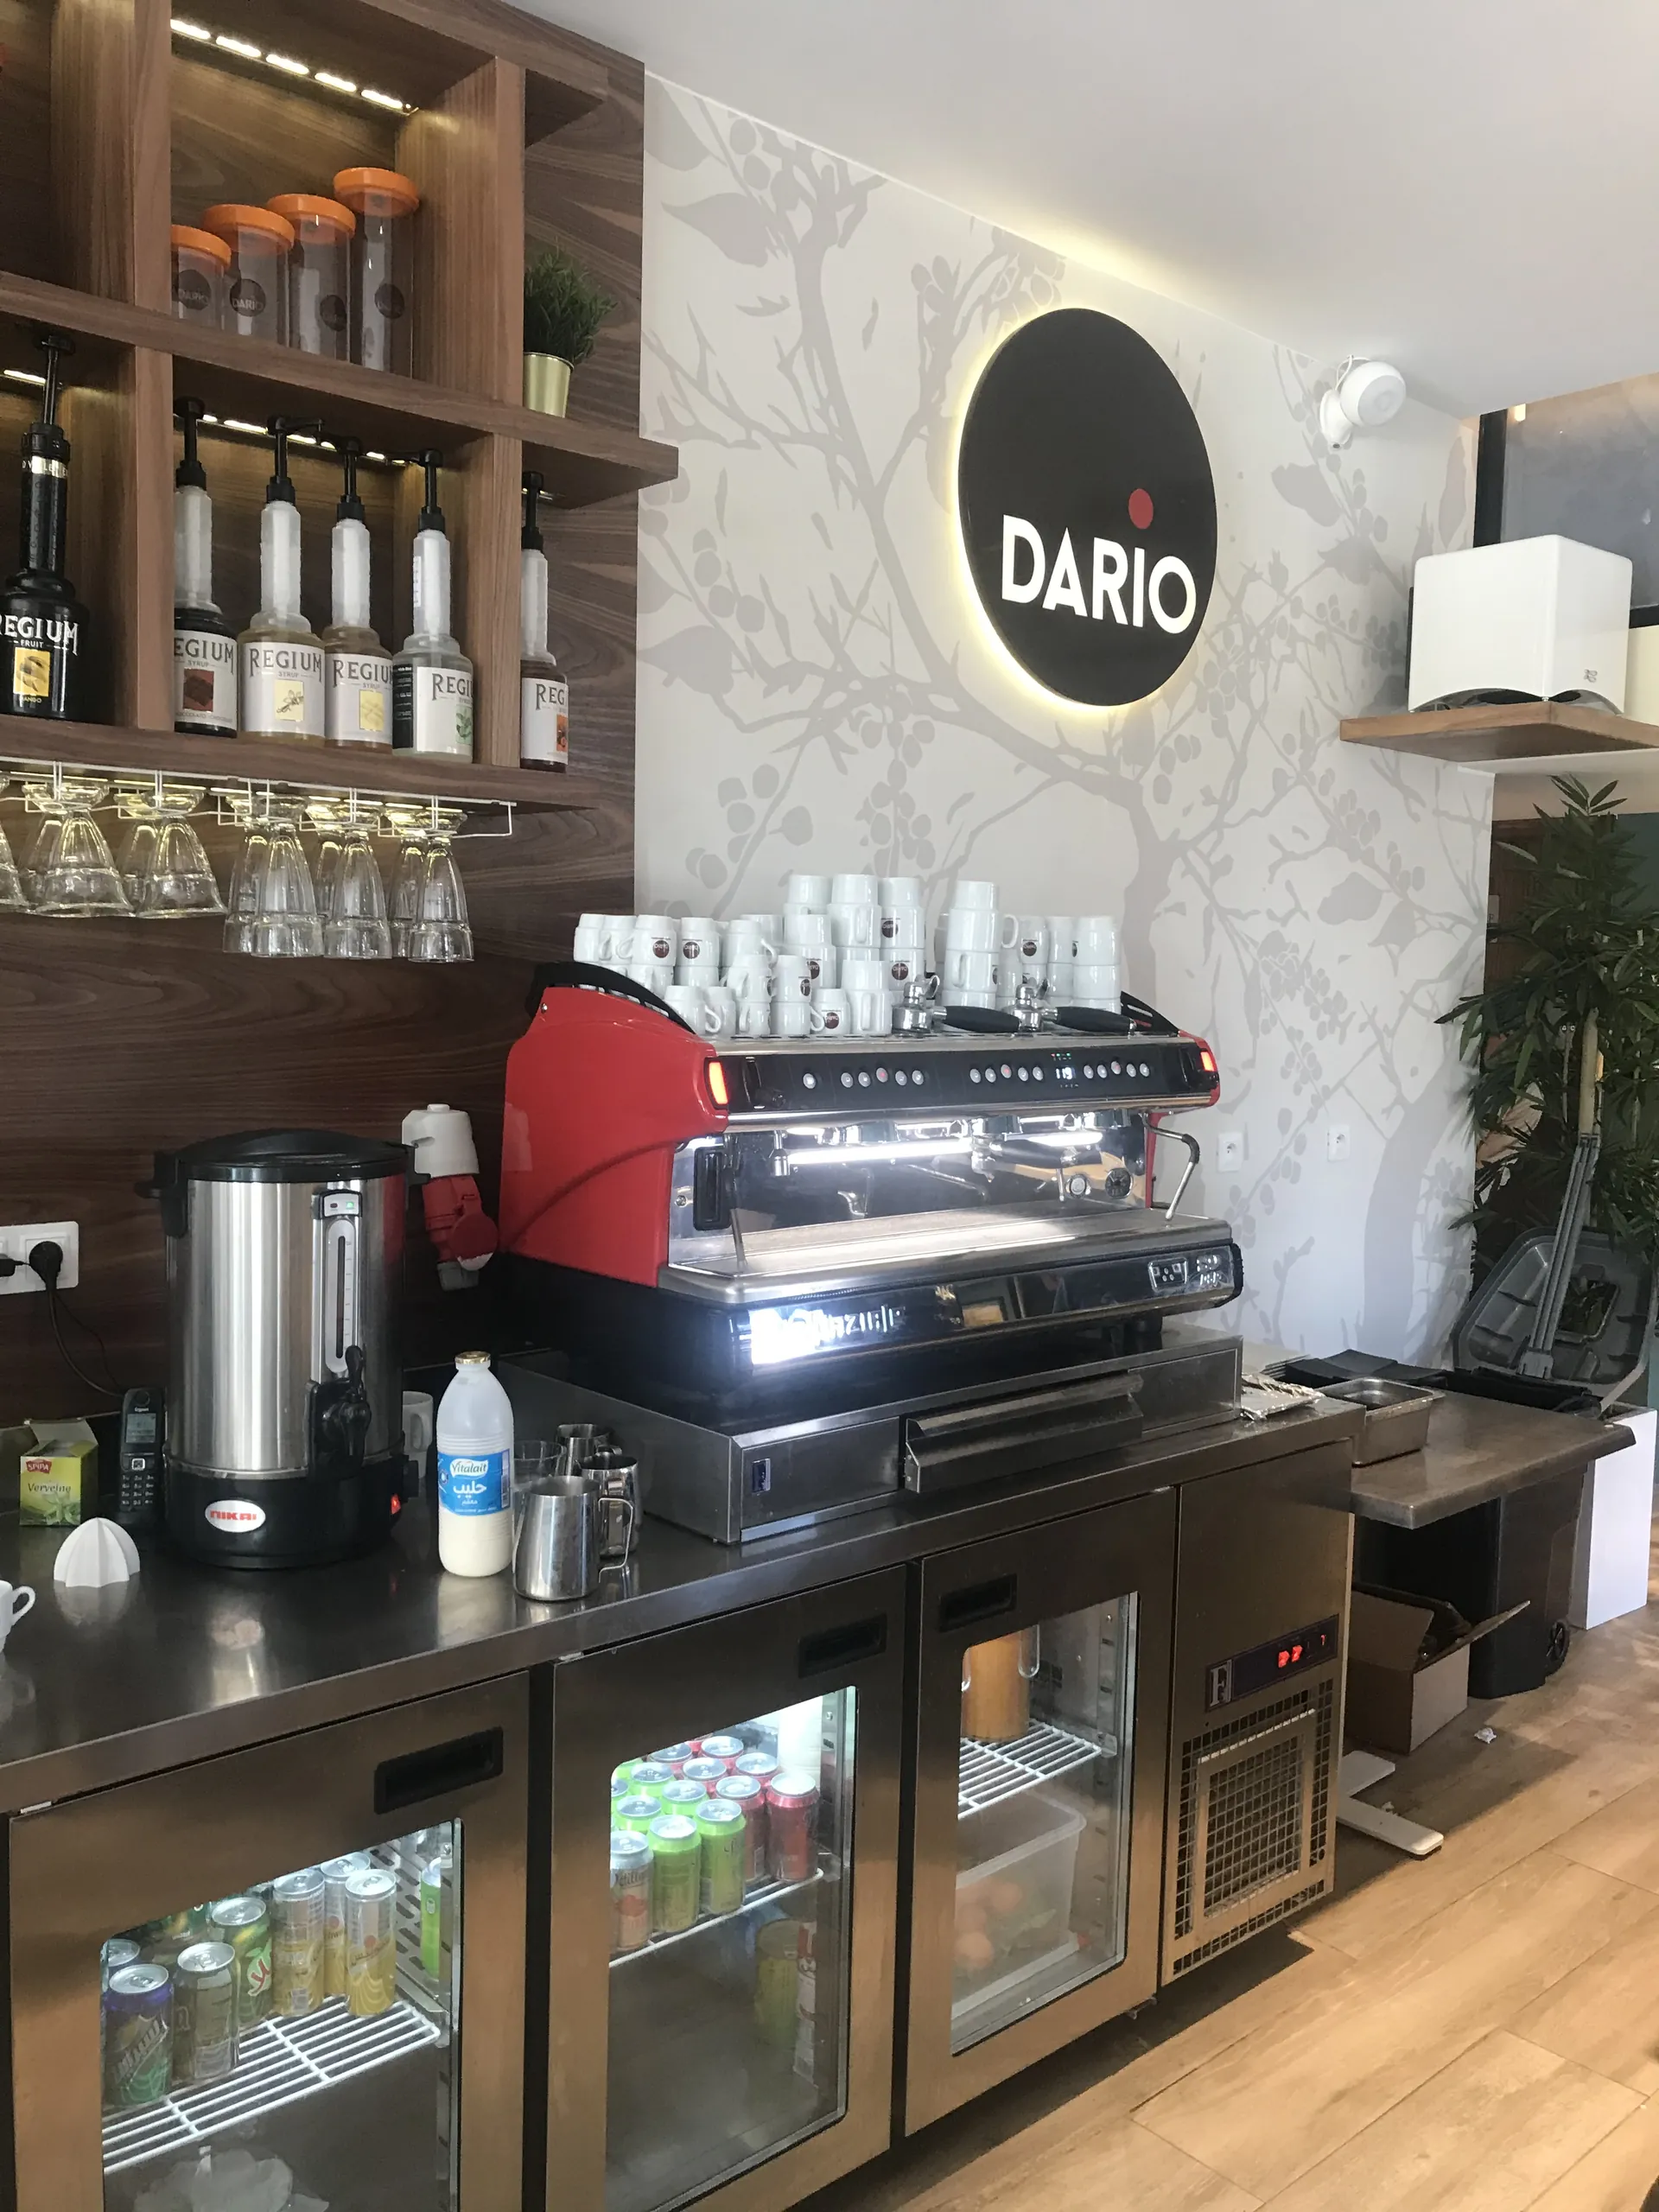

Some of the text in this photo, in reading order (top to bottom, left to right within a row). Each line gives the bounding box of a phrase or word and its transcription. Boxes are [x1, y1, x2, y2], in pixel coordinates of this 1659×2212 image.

[1001, 513, 1197, 634] DARIO
[0, 614, 79, 656] EGIUM
[174, 638, 234, 675] EGIUM
[250, 648, 322, 683] REGIUM
[333, 659, 393, 689] REGIU
[432, 672, 473, 701] REGI
[452, 1460, 487, 1472] Vitalait
[28, 1483, 72, 1492] Verveine
[453, 1480, 487, 1498] حليب
[210, 1510, 257, 1522] NIKAI
